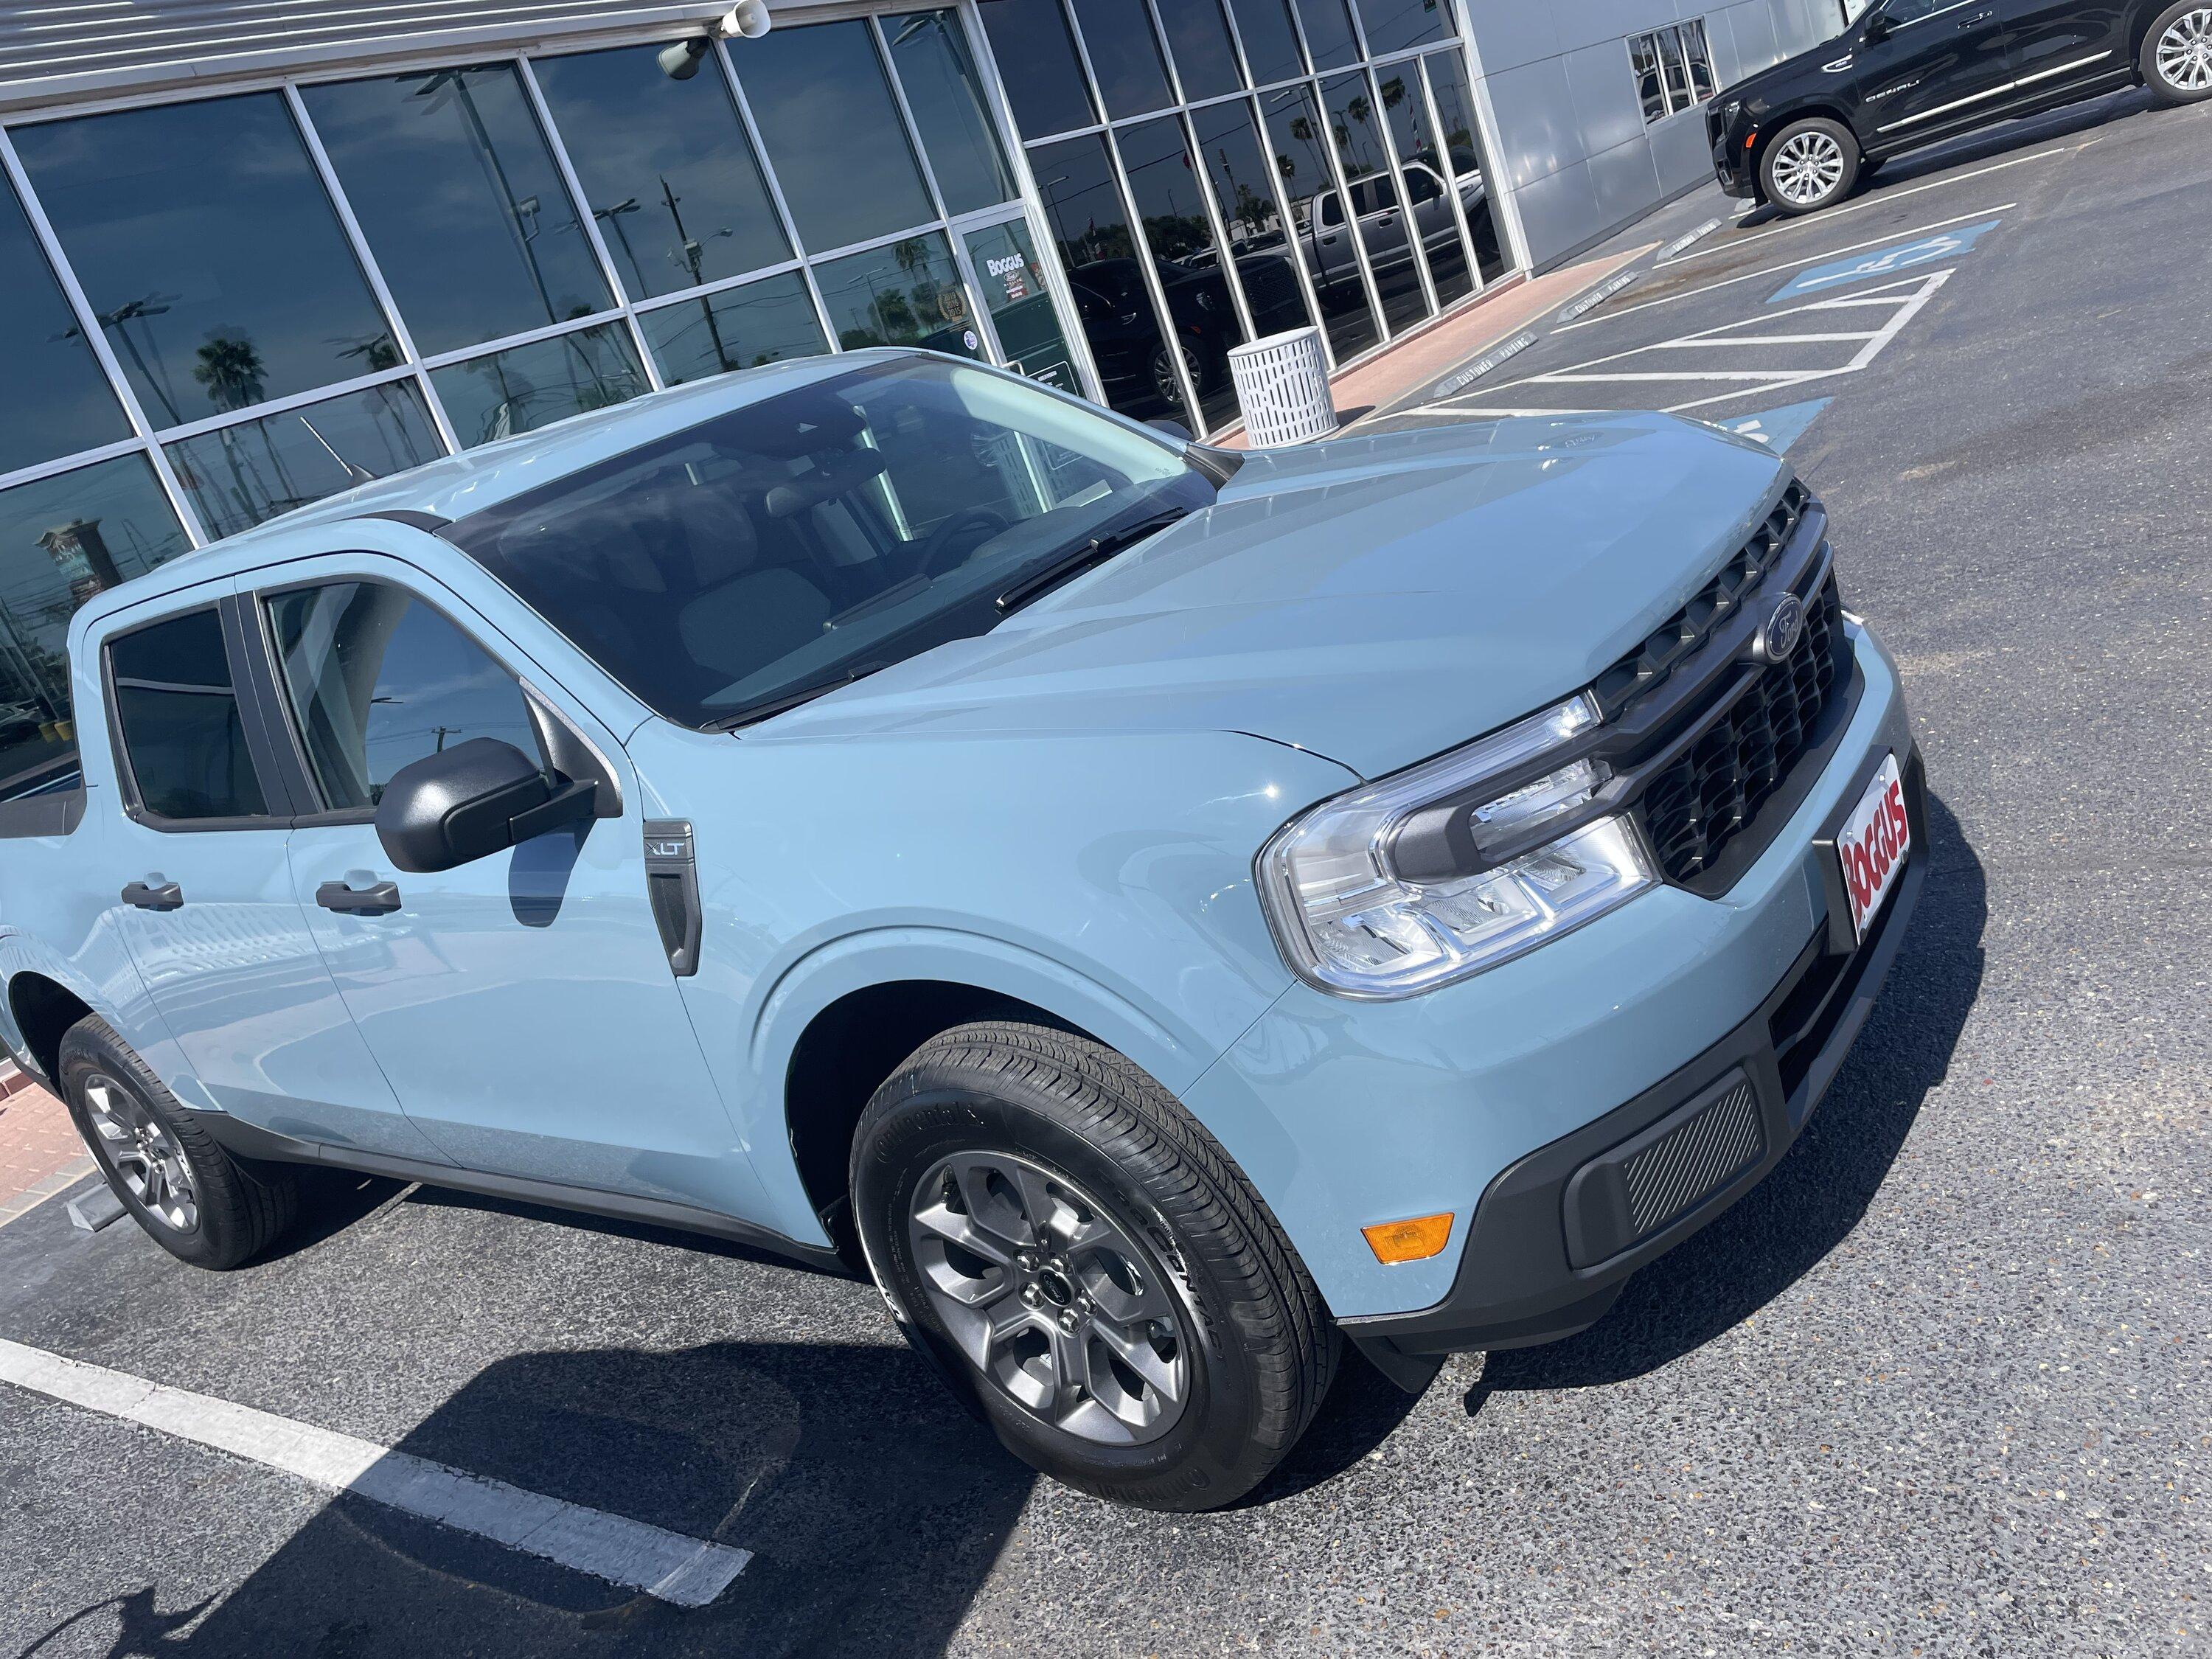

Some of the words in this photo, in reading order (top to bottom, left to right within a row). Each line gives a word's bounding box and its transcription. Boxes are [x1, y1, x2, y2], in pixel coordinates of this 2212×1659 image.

[1865, 79, 1920, 102] DENALI
[1574, 292, 1603, 313] CUSTOMER
[1455, 359, 1495, 386] CUSTOMER
[1499, 337, 1528, 358] PARKING
[1778, 608, 1799, 650] Ford
[645, 842, 685, 855] XLT
[1843, 779, 1907, 928] BOGGUS
